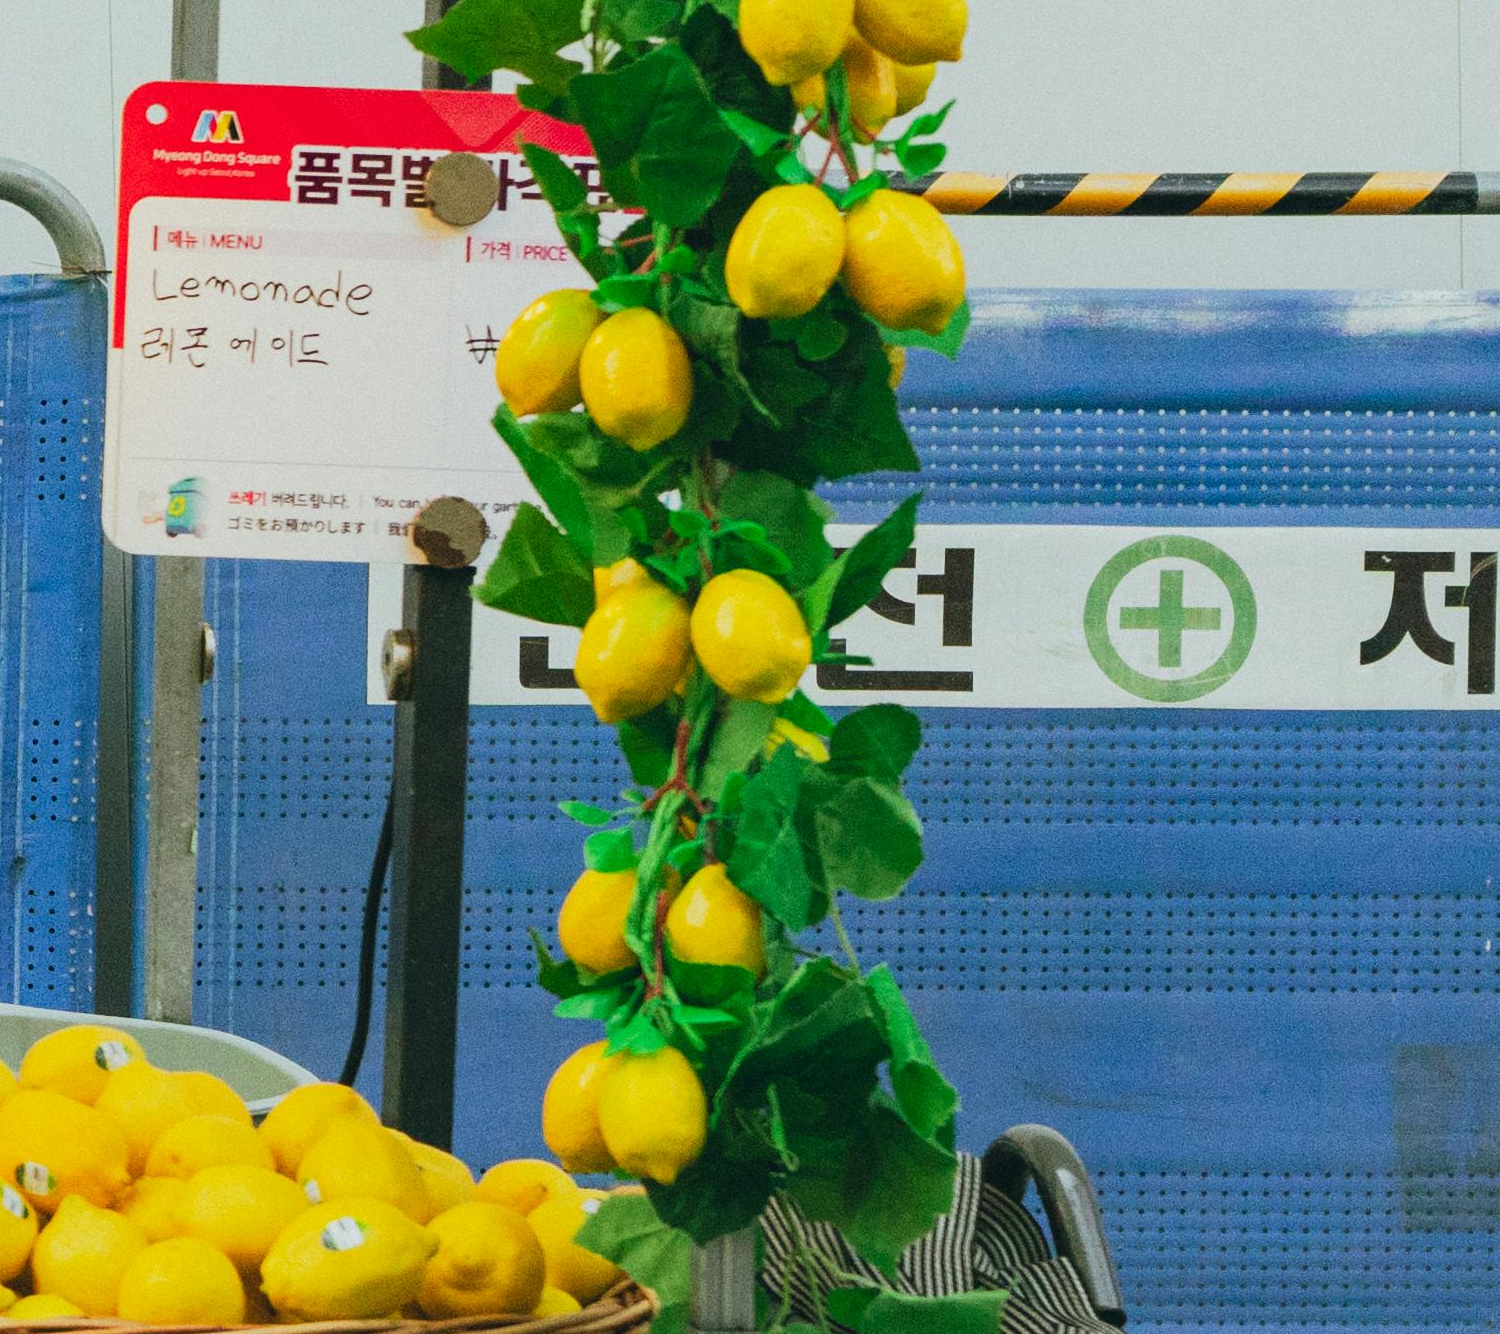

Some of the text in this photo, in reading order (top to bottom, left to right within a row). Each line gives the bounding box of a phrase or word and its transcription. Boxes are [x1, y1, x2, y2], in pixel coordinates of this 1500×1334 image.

[153, 149, 281, 165] Myeong Dong Square
[167, 230, 263, 249] 메뉴 MENU
[480, 241, 568, 261] 가격 PRICE
[152, 269, 373, 315] Lemonade
[228, 491, 267, 506] 쓰레기
[372, 496, 419, 509] You can
